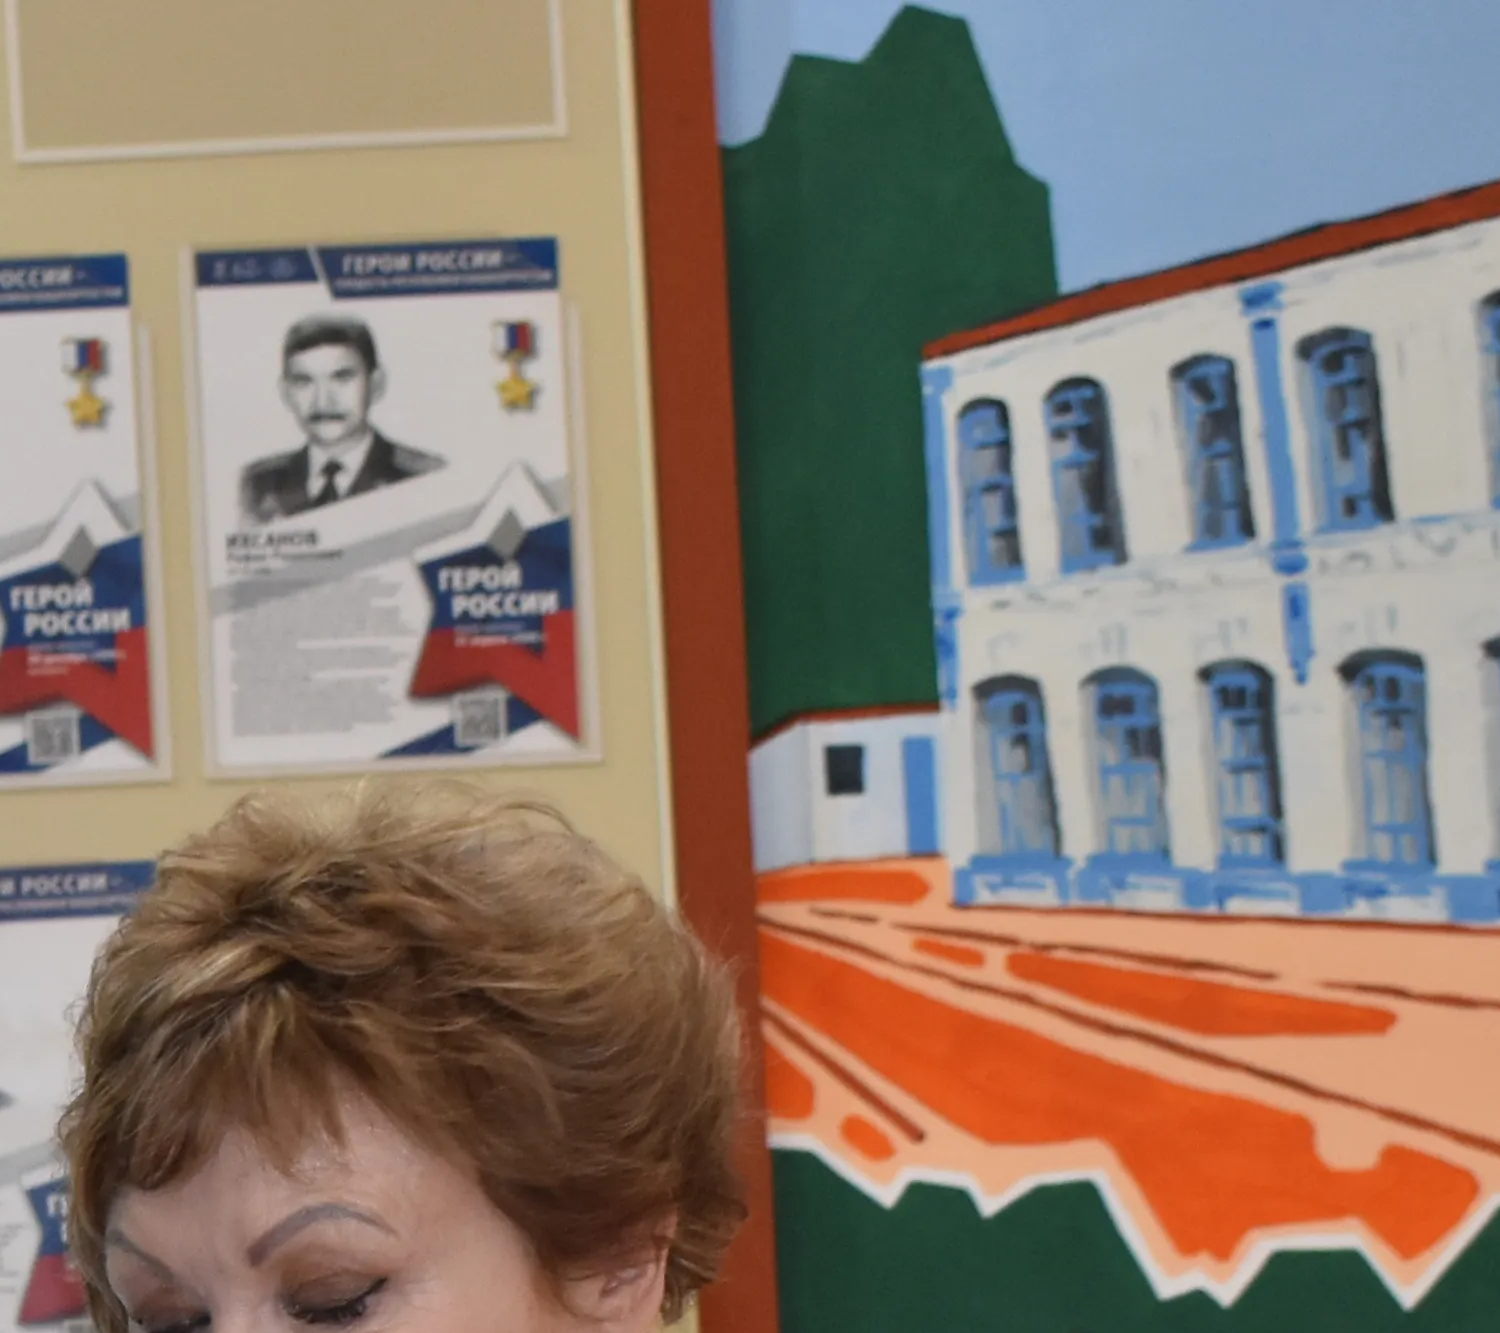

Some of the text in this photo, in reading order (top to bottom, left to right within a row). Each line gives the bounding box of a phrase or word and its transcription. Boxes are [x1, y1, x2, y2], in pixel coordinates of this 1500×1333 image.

[438, 563, 522, 592] ГЕРОЙ
[10, 580, 94, 610] ГЕРОЙ
[452, 590, 558, 619] РОССИИ
[24, 607, 131, 637] РОССИИ
